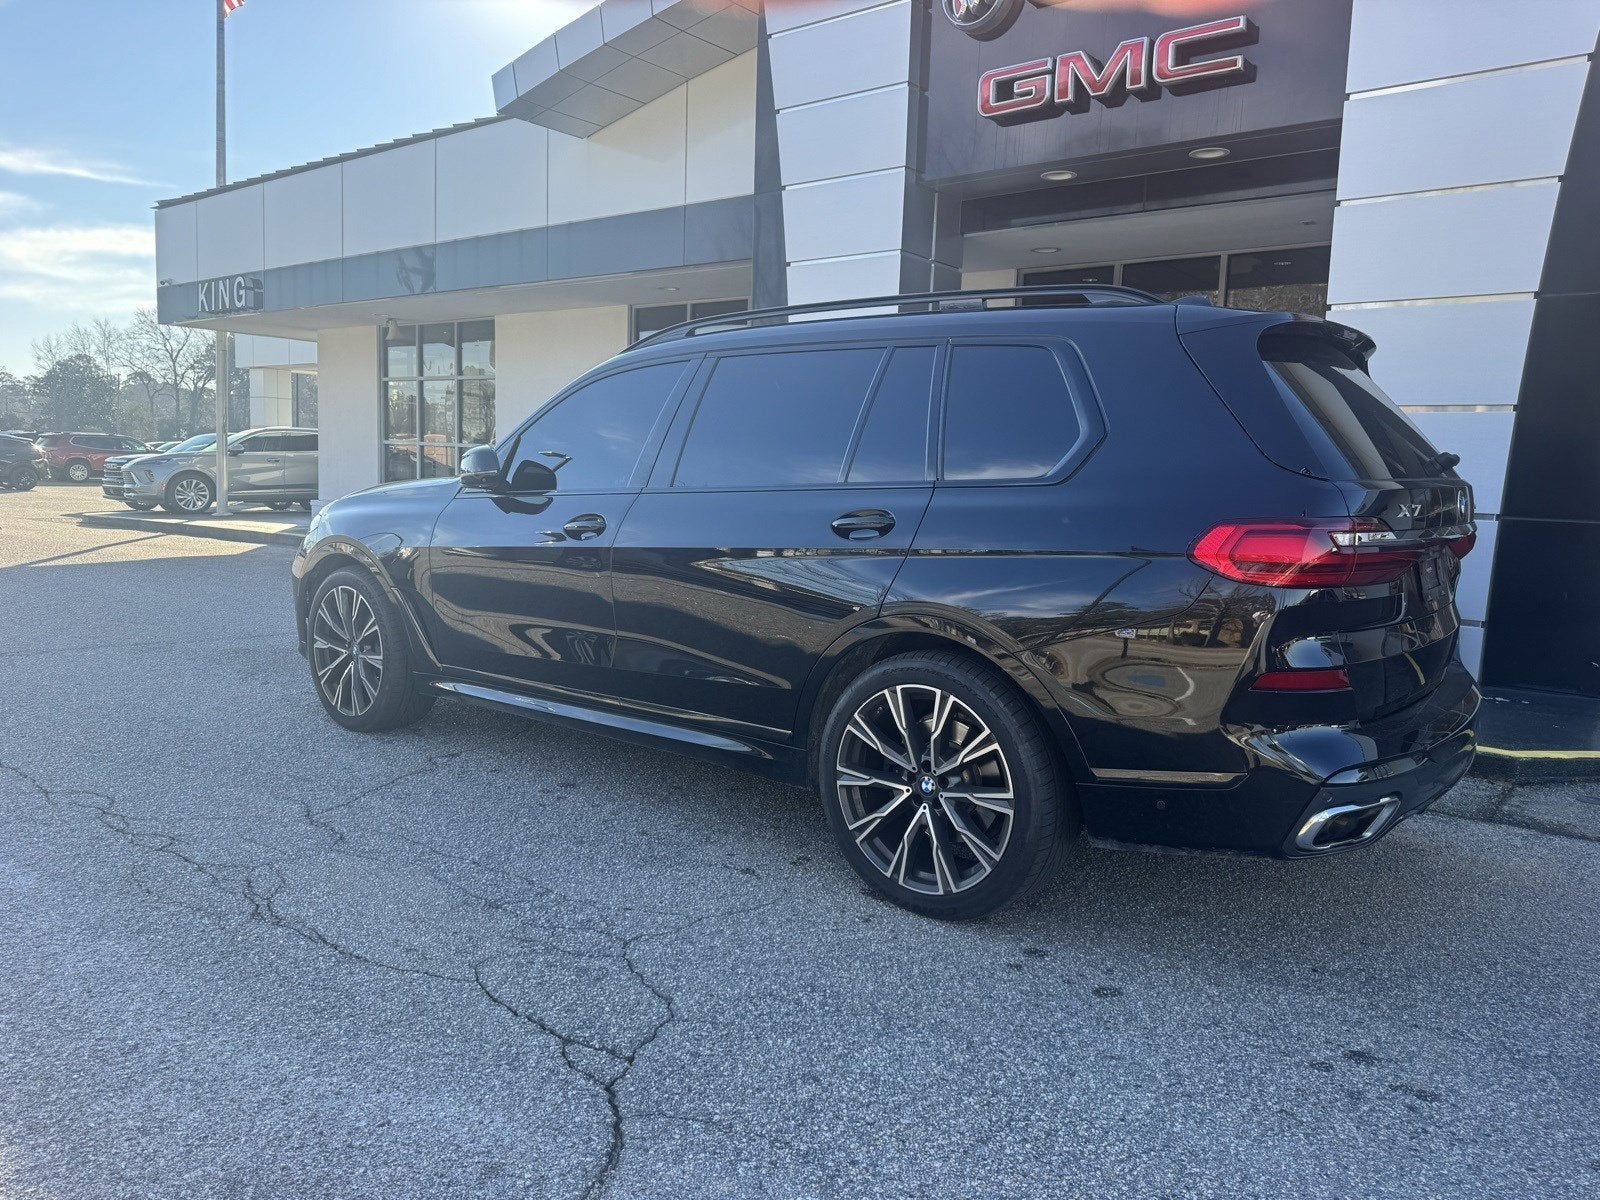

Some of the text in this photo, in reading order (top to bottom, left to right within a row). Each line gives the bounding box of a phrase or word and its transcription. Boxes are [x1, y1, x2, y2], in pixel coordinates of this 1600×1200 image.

[977, 15, 1248, 118] GMC
[198, 276, 247, 312] KING
[1397, 503, 1422, 519] X7
